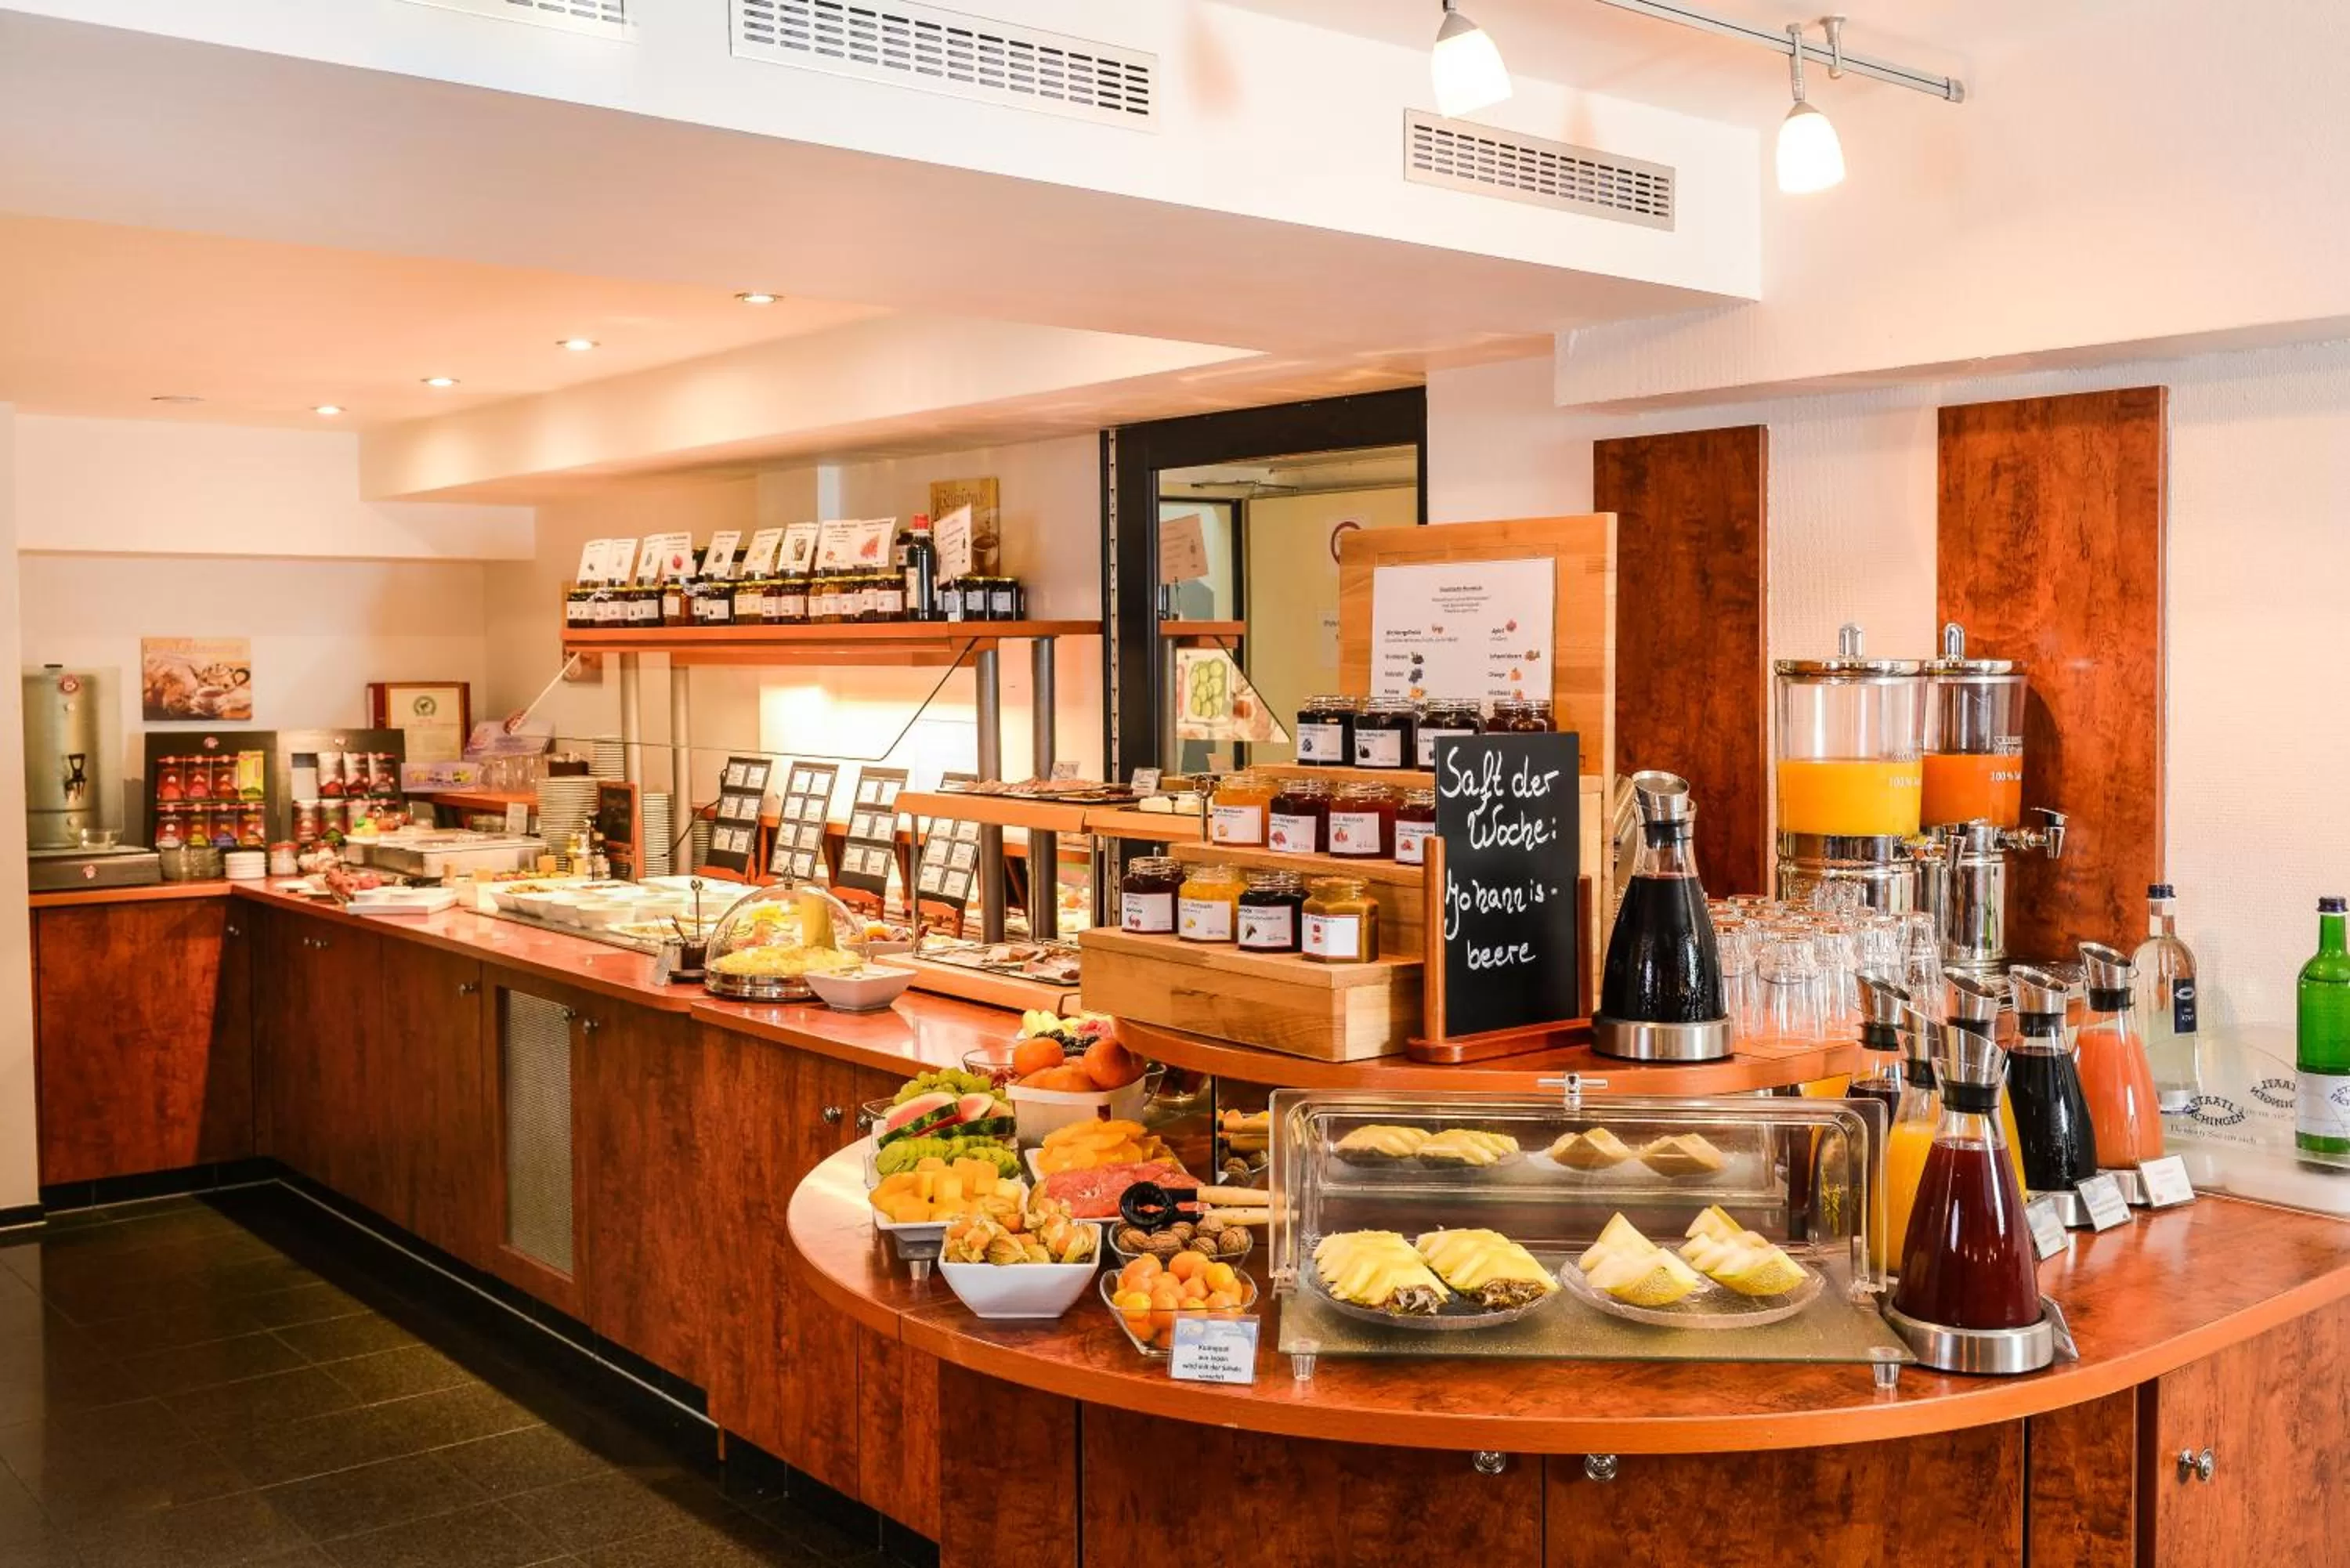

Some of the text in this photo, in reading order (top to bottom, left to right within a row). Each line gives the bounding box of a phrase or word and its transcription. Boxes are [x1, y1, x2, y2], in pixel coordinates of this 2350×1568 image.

[1440, 746, 1560, 815] Saft der
[1467, 803, 1557, 851] Woche:
[1467, 939, 1536, 970] beere
